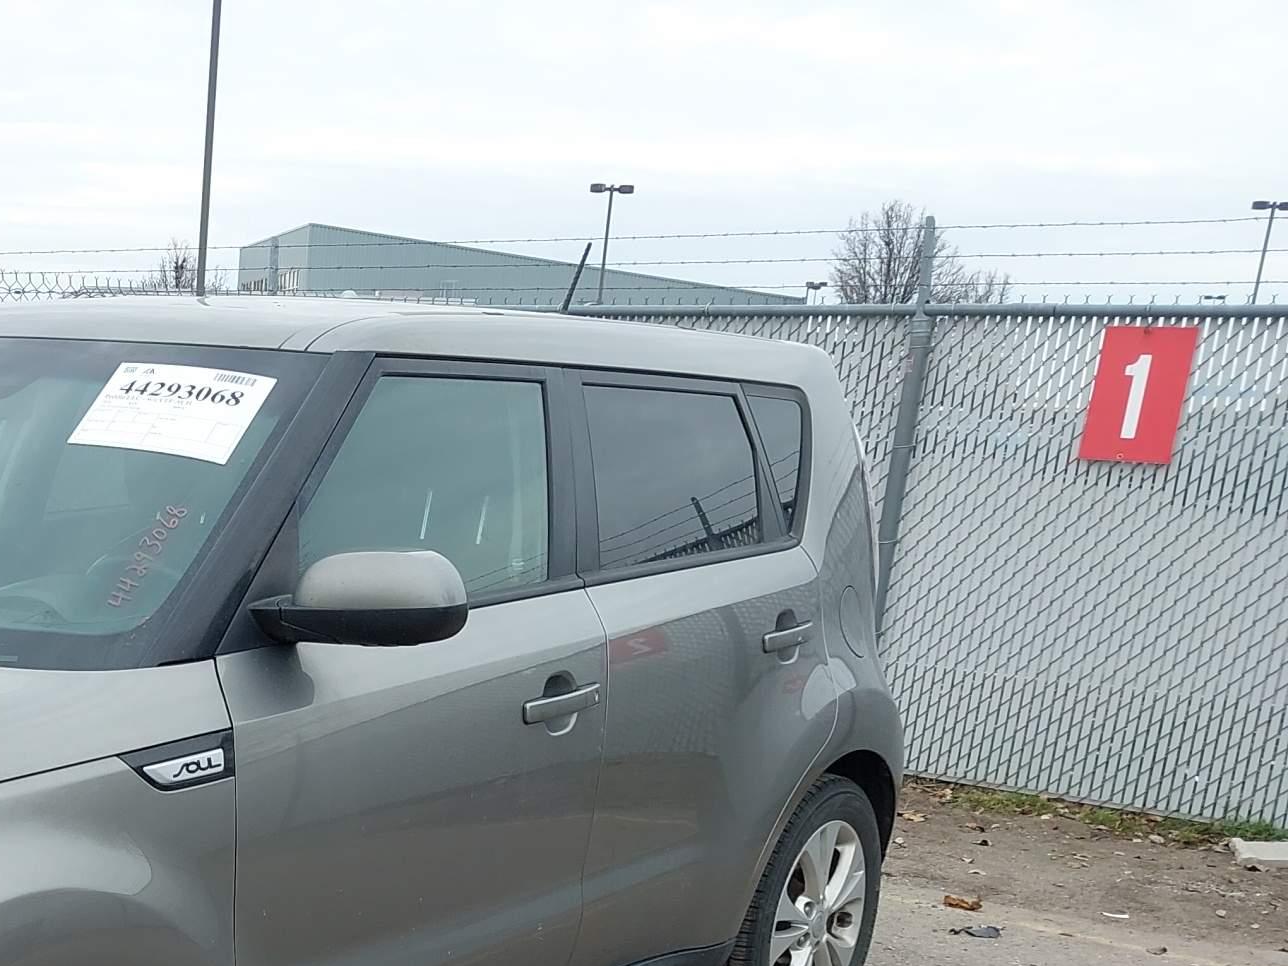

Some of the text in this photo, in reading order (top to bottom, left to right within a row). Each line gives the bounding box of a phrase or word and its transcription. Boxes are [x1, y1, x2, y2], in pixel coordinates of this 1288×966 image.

[119, 379, 245, 407] 44293068
[1120, 354, 1153, 440] 1
[106, 505, 188, 607] 44293068
[172, 757, 223, 779] SOUL
